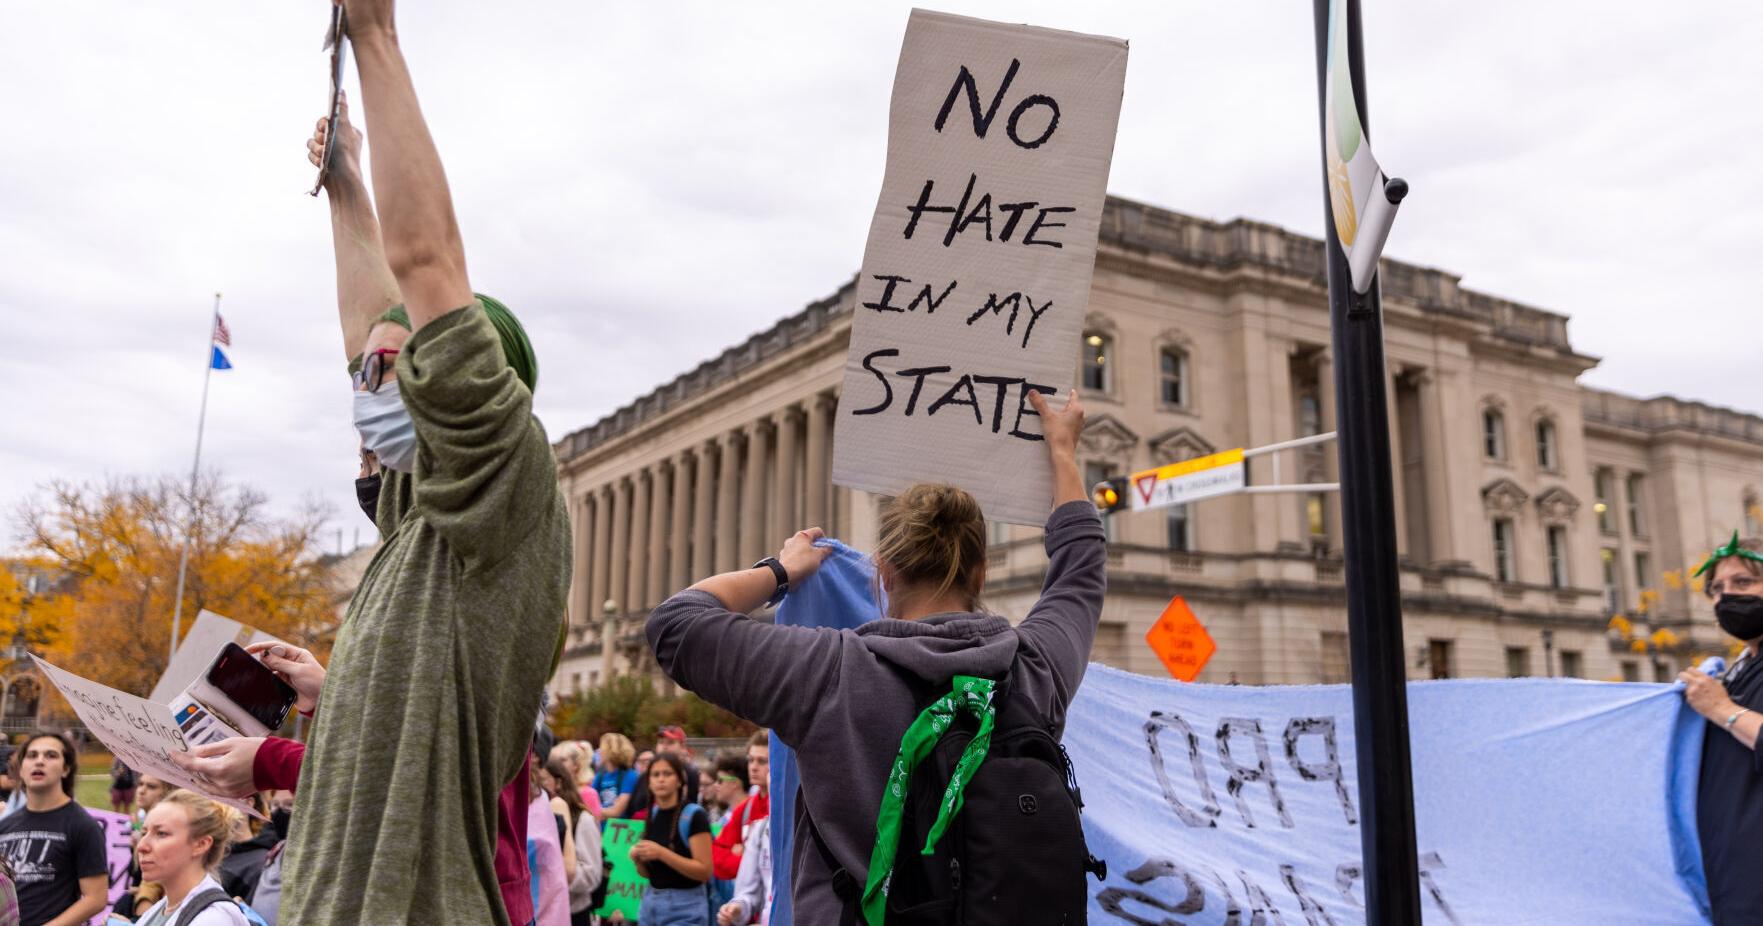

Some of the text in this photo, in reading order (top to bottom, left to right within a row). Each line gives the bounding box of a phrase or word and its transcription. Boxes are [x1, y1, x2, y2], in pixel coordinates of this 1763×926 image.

[934, 58, 1061, 149] NO
[903, 172, 1076, 249] HATE
[862, 274, 1053, 348] IN MY
[852, 349, 1057, 441] STATE
[112, 695, 189, 752] feeling
